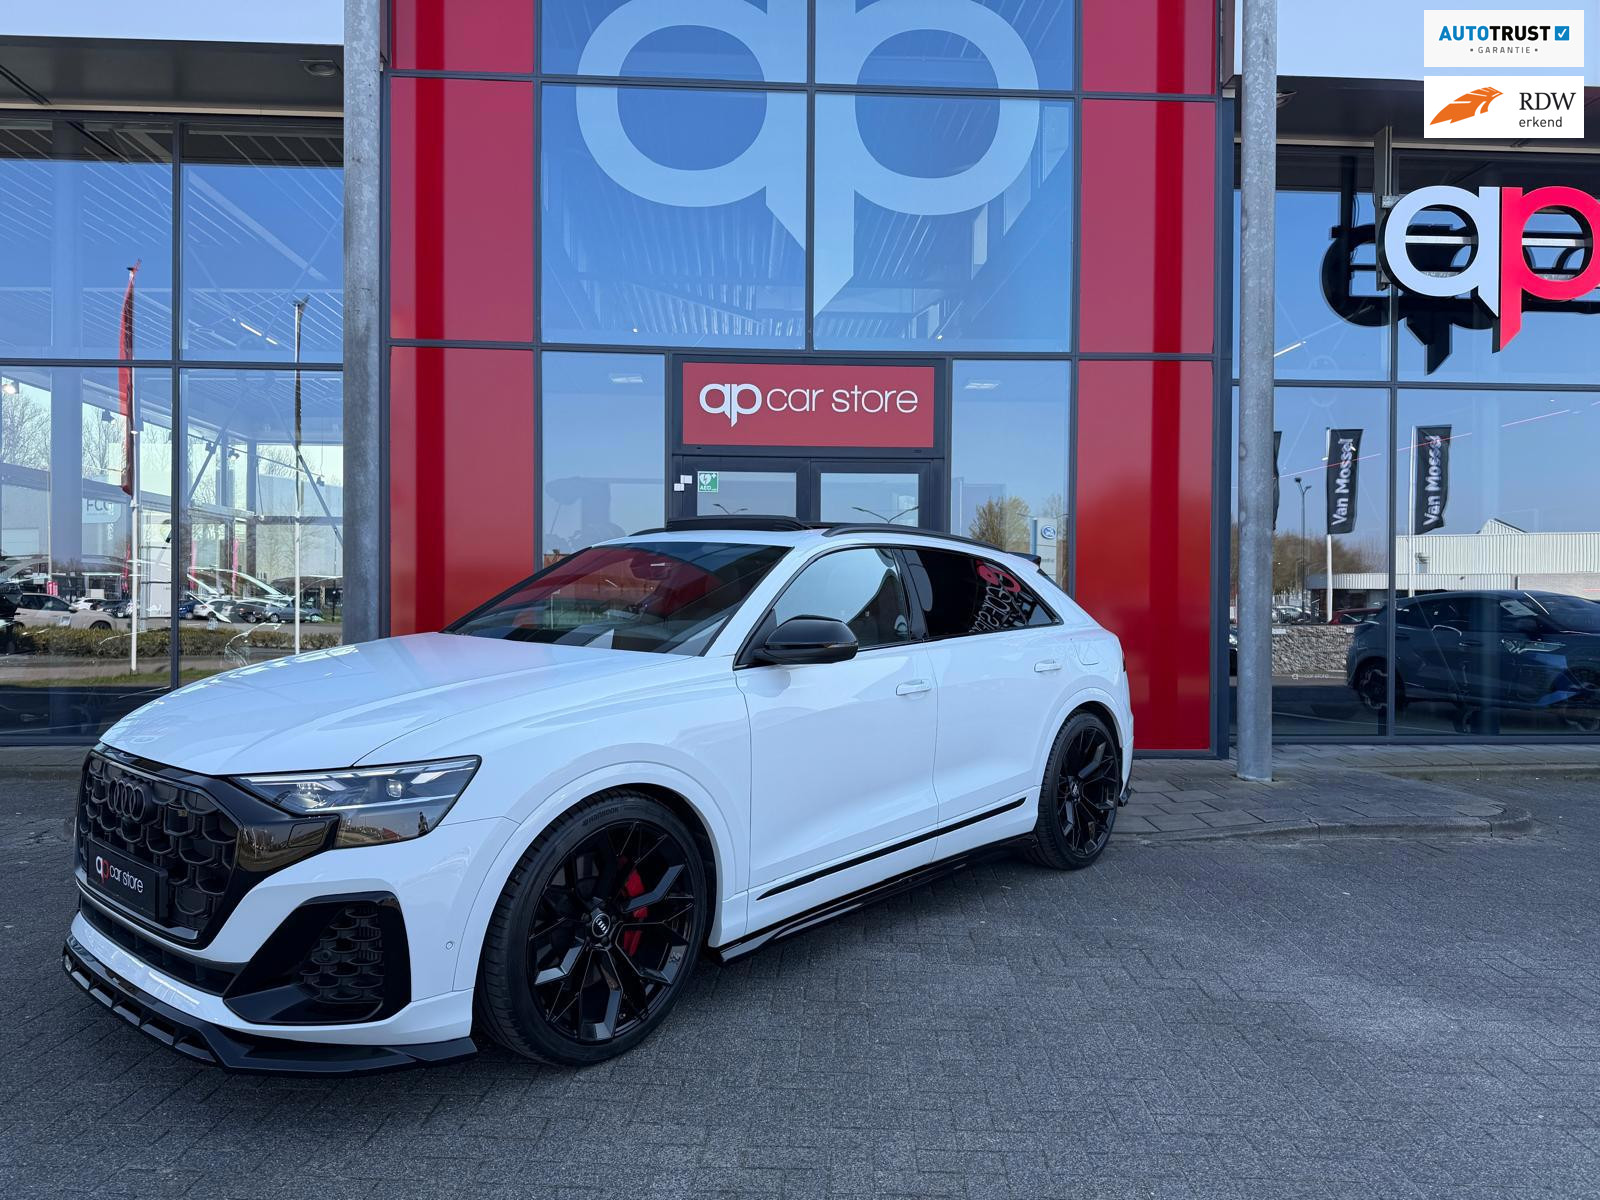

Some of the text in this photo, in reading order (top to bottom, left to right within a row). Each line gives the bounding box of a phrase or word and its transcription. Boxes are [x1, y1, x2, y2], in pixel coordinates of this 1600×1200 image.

[699, 383, 918, 427] ap car store
[1331, 498, 1349, 525] Van
[1423, 495, 1441, 526] Van
[110, 865, 122, 882] car
[122, 871, 144, 893] store
